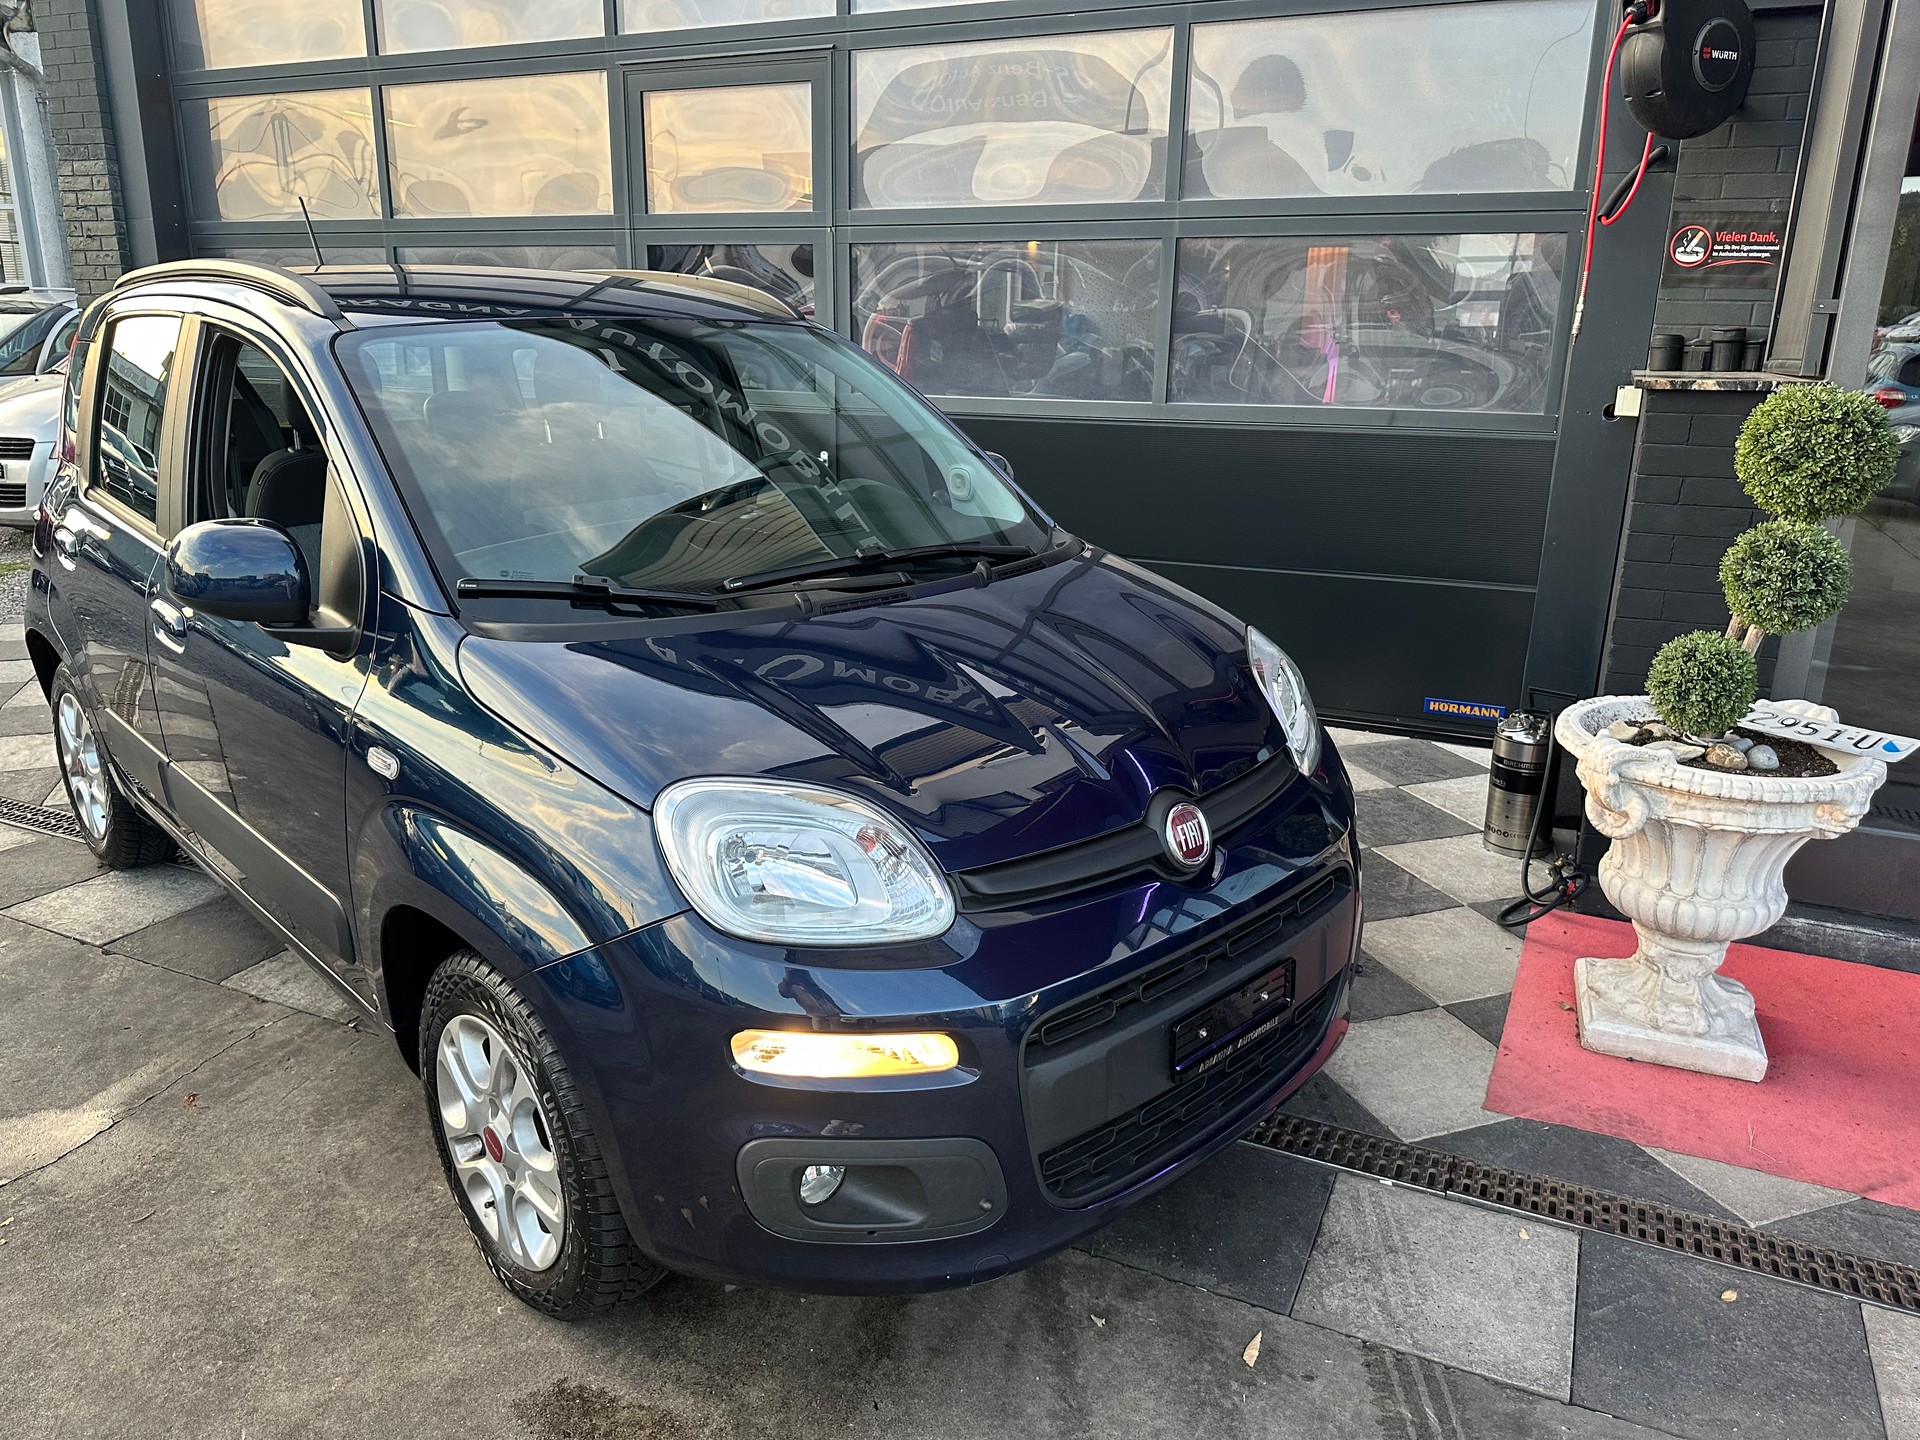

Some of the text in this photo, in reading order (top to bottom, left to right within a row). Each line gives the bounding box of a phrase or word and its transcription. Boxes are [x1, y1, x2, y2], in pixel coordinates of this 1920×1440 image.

[1711, 49, 1738, 61] WÜRTH
[1715, 231, 1779, 244] Vielen Dank,
[1429, 701, 1500, 718] HÖRMANN
[1503, 759, 1543, 771] BIRCHME
[1176, 818, 1203, 852] FIAT
[1237, 1016, 1279, 1048] AUTOMOBILE
[542, 1091, 582, 1211] UNIROYAL
